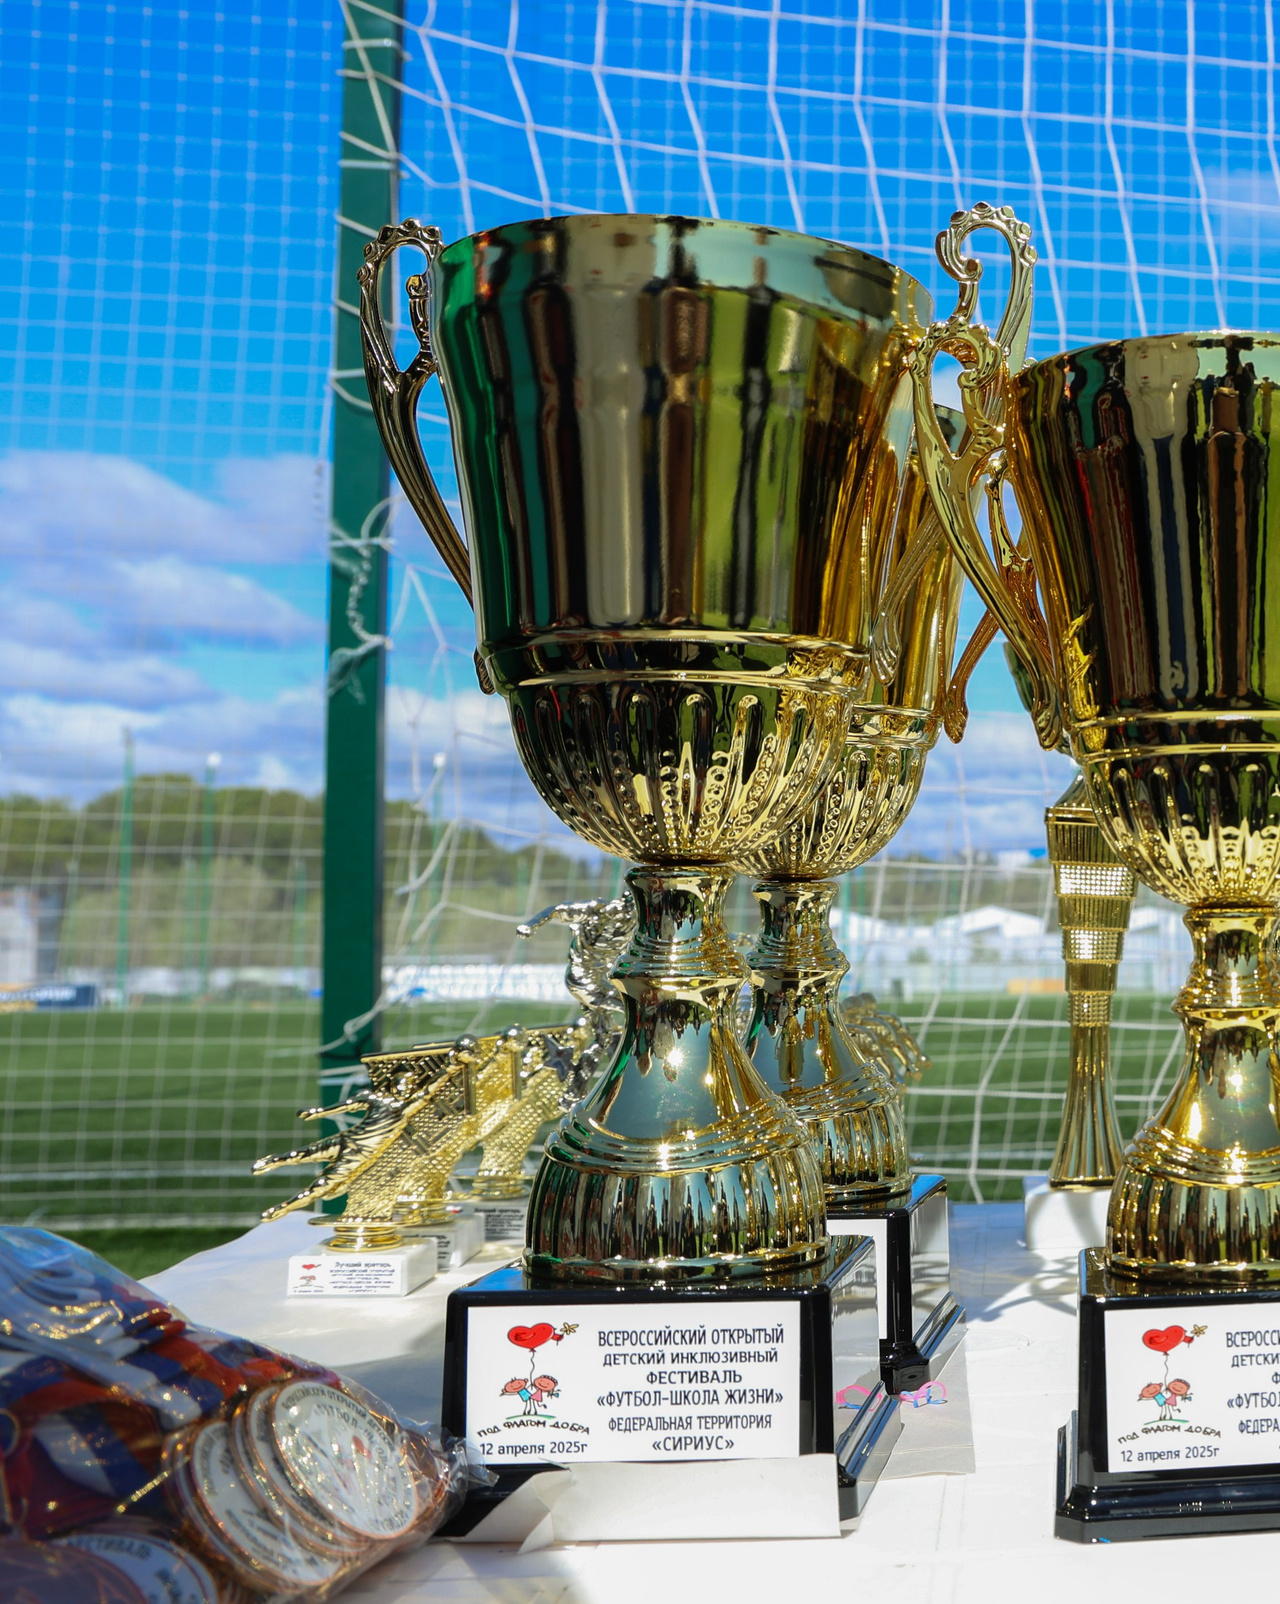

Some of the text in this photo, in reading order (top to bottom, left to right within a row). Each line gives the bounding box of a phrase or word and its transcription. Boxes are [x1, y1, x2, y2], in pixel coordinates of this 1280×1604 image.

[598, 1323, 784, 1347] ВСЕРОССИЙСКИЙ ОТКРЫТЫЙ
[603, 1347, 778, 1367] ДЕТСКИЙ ИНКЛЮЗИВНЫЙ
[646, 1370, 742, 1384] ФЕСТИВАЛЬ
[724, 1388, 783, 1405] ЖИЗНИ»
[503, 1419, 546, 1429] ФЛАГОМ
[549, 1421, 590, 1435] ДОБРА
[608, 1414, 772, 1433] ФЕДЕРАЛЬНАЯ ТЕРРИТОРИЯ
[1141, 1425, 1181, 1434] ФЛАГОМ
[1184, 1425, 1221, 1438] ДОБРА
[480, 1441, 588, 1457] 12 апреля 2025г
[652, 1435, 734, 1451] «СИРИУС»
[1121, 1445, 1219, 1463] 12 апреля 2025г
